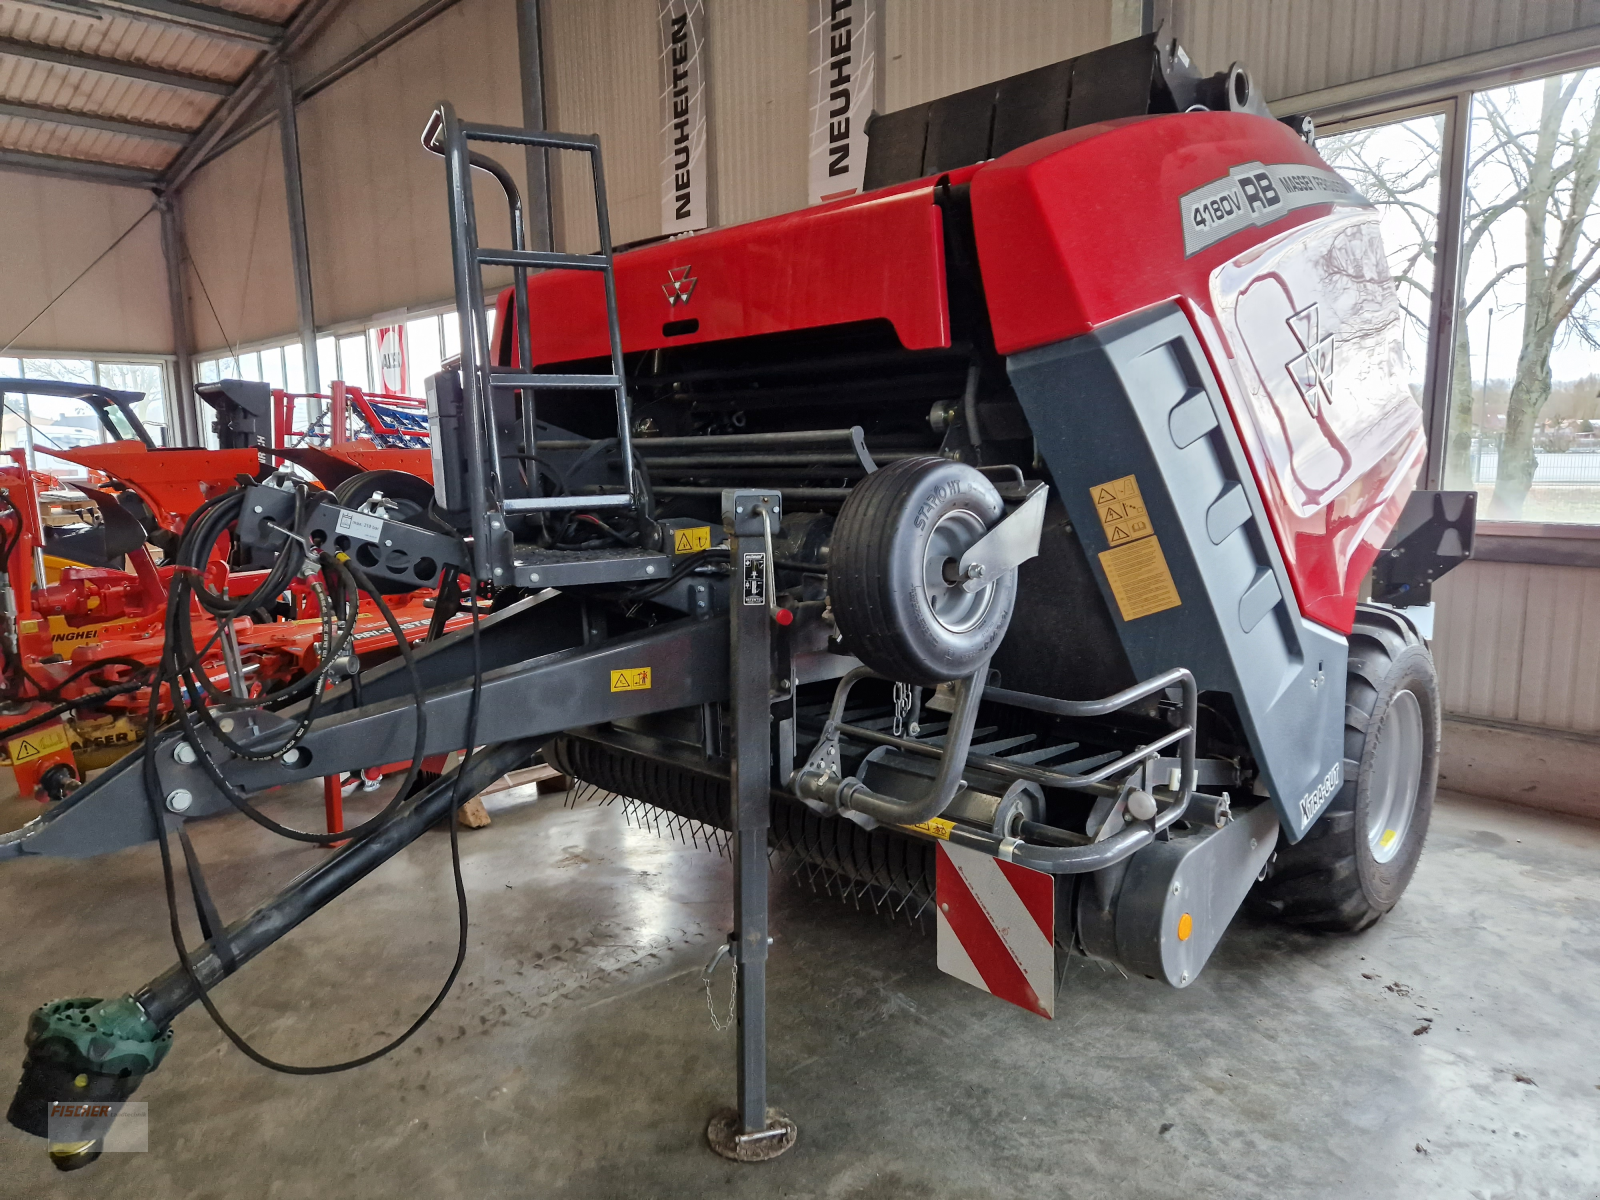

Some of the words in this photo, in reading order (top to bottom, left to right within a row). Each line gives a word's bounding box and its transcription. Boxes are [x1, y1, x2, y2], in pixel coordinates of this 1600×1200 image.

[671, 12, 691, 220] NEUHEITEN
[1193, 190, 1241, 227] 4180V
[1237, 172, 1281, 214] RB
[1278, 175, 1317, 194] MASSEY
